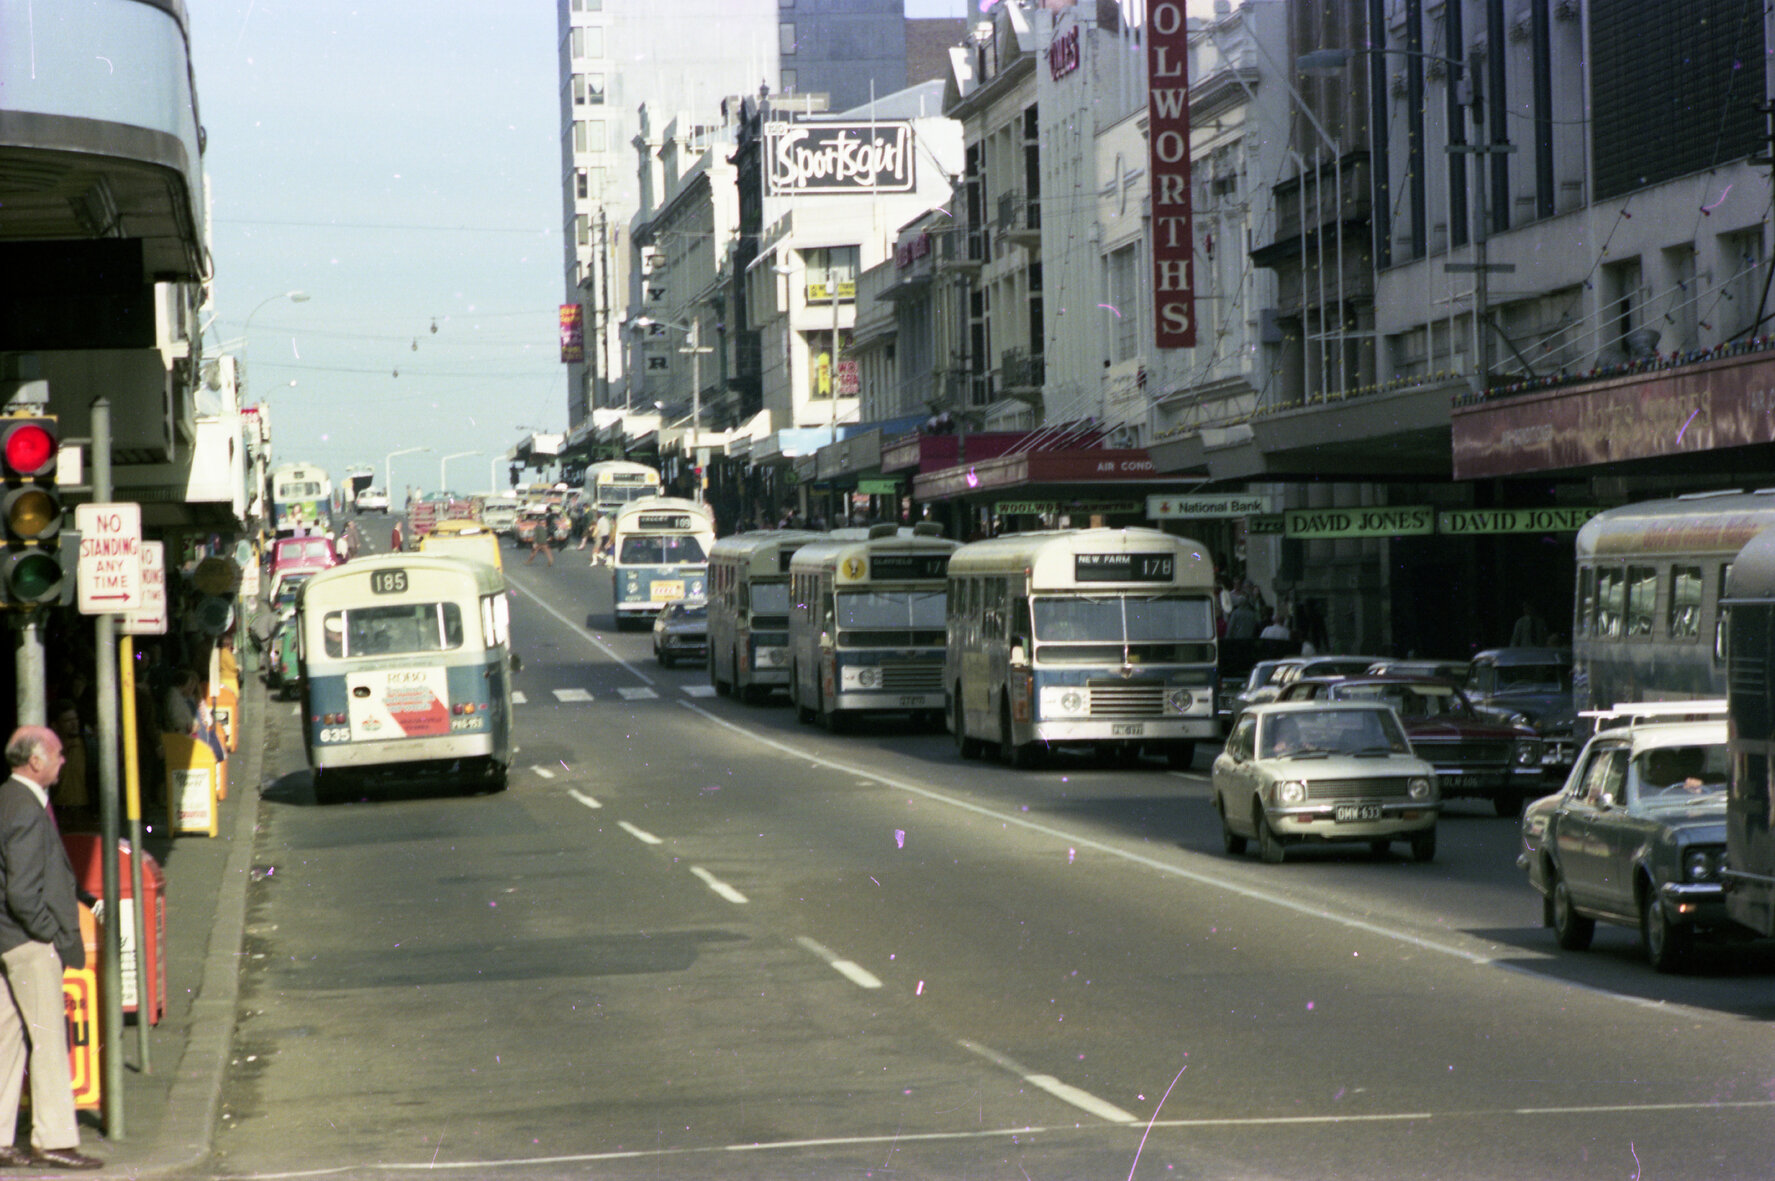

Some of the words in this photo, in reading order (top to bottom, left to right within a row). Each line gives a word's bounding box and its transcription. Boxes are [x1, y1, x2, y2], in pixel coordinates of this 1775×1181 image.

[773, 129, 905, 187] Sportsgirl
[1097, 461, 1115, 472] AIR
[1179, 500, 1226, 514] National
[1231, 498, 1262, 512] Bank
[96, 514, 121, 533] NO
[1293, 514, 1350, 533] DAVID
[1451, 512, 1517, 532] DAVID
[80, 536, 137, 557] STANDING
[96, 560, 124, 572] ANY
[927, 559, 947, 574] 17
[1078, 556, 1099, 564] NEW
[1104, 556, 1130, 564] FARM
[1143, 559, 1172, 575] 178
[94, 575, 128, 588] TIME
[376, 572, 404, 592] 185
[320, 728, 350, 742] 635
